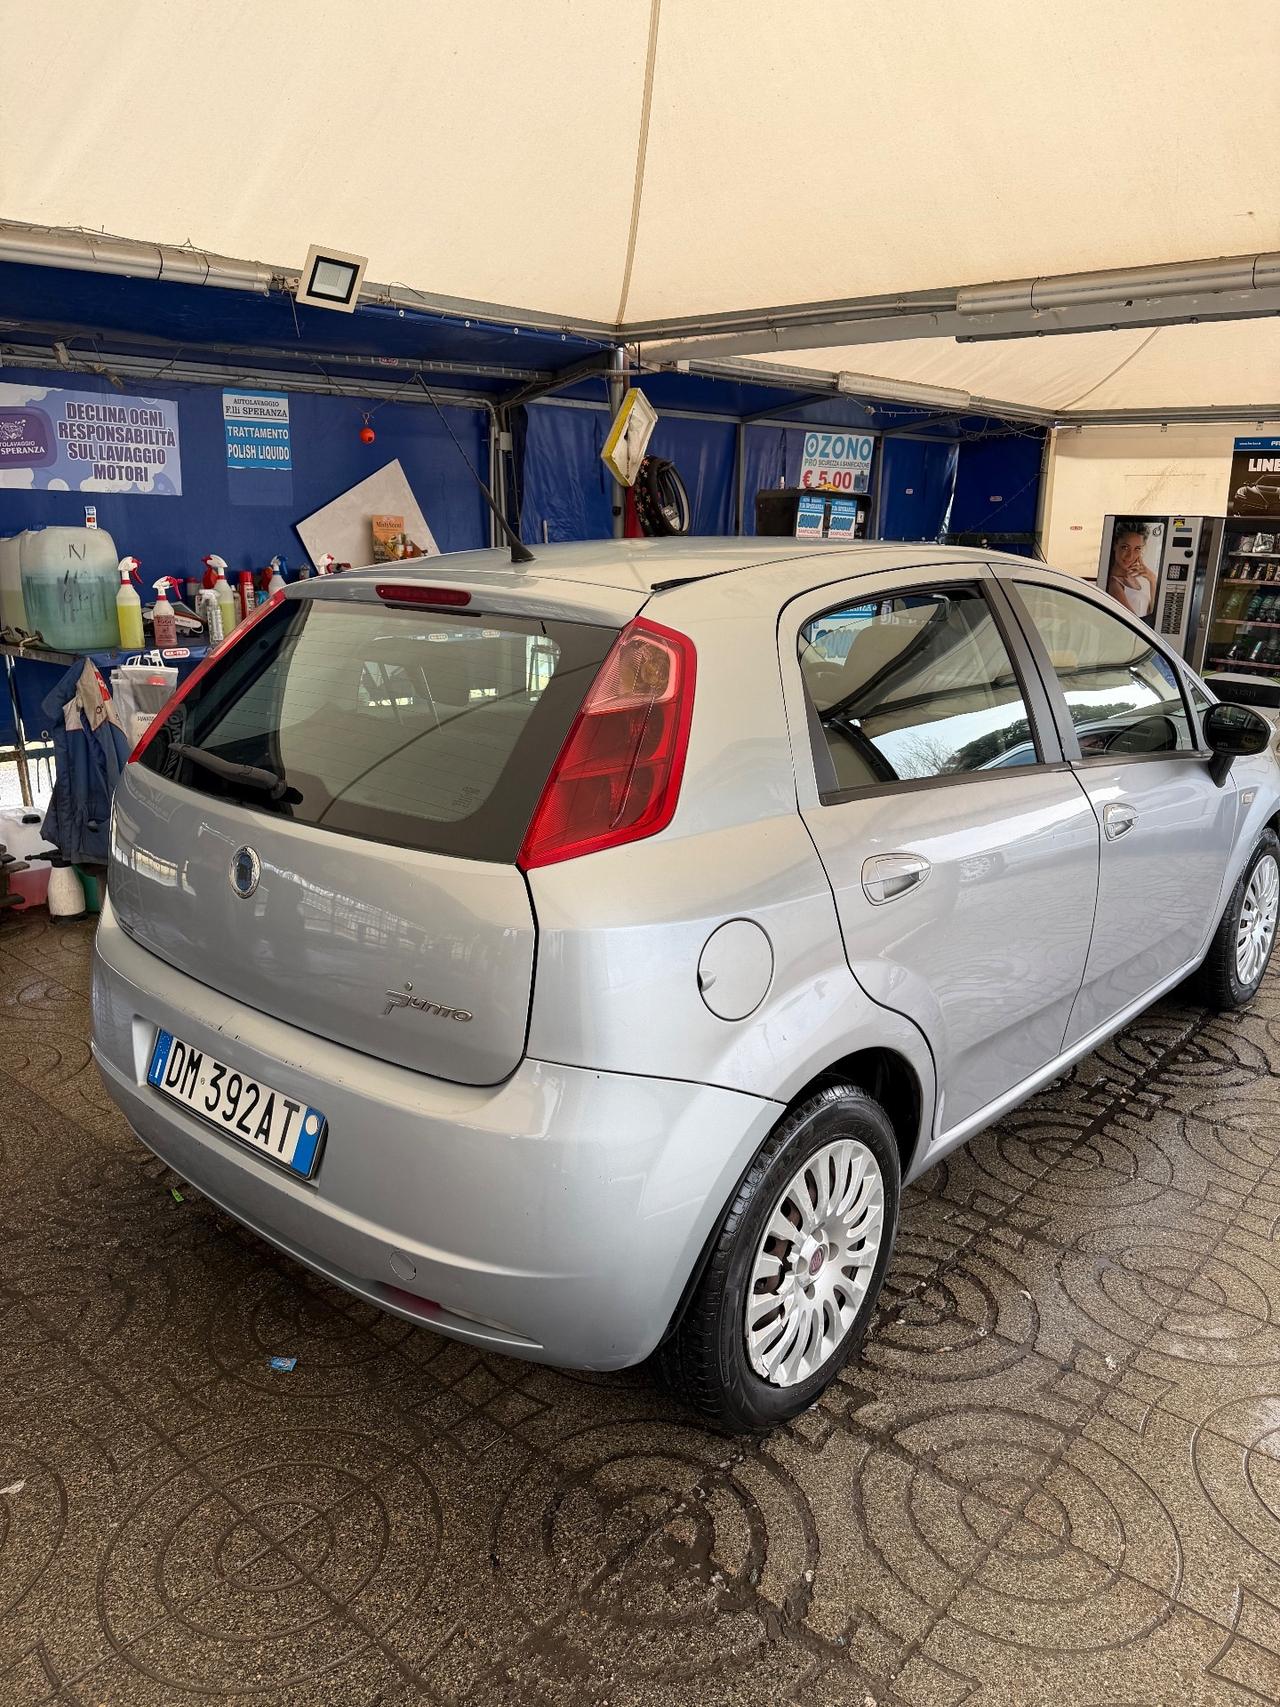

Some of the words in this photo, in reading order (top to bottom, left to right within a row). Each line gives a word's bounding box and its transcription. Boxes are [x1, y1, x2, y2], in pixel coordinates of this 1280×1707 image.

[233, 398, 280, 408] AUTOLAVAGGIO
[242, 407, 288, 418] SPERANZA
[66, 402, 127, 424] DECLINA
[129, 408, 164, 428] OGNI
[58, 421, 176, 448] RESPONSABILITÀ
[227, 425, 289, 440] TRATTAMENTO
[0, 446, 46, 456] SPERANZA
[68, 442, 96, 461] SUL
[99, 446, 167, 465] LAVAGGIO
[228, 443, 257, 459] POLISH
[258, 445, 290, 461] LIQUIDO
[805, 433, 872, 461] OZONO
[93, 463, 149, 483] MOTORI
[165, 1039, 203, 1100] DM
[204, 1062, 300, 1153] 392AT
